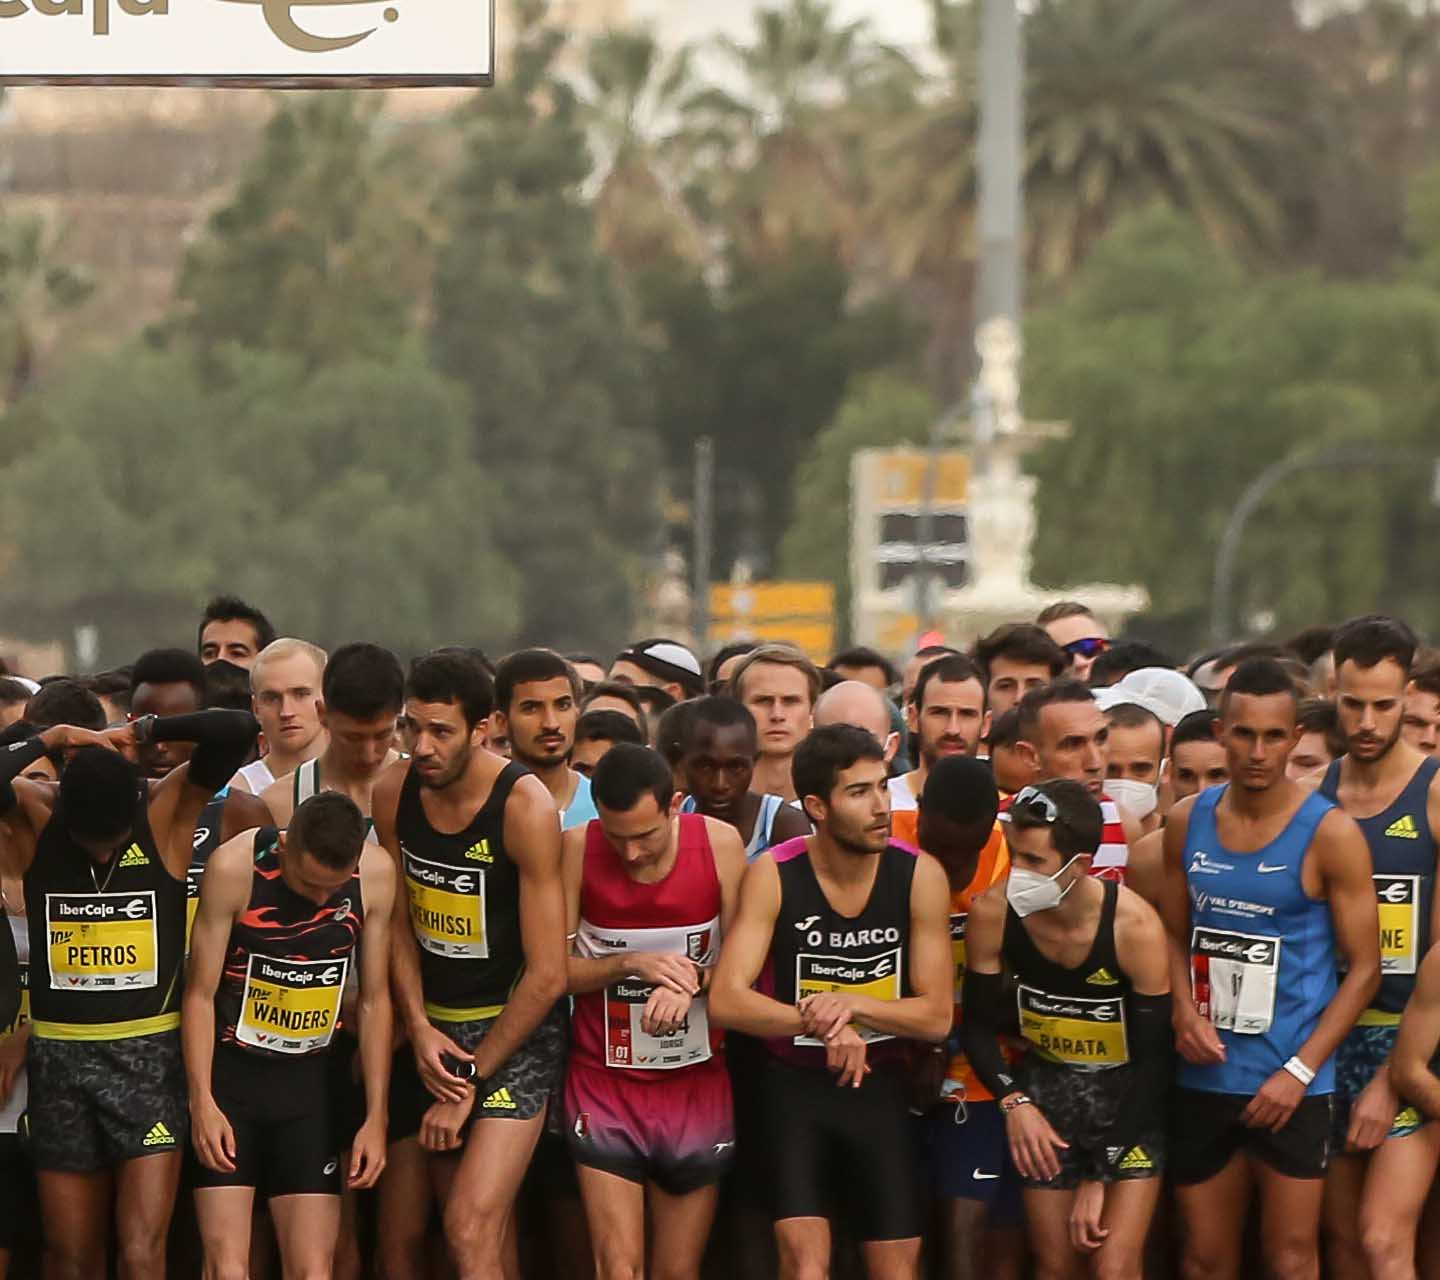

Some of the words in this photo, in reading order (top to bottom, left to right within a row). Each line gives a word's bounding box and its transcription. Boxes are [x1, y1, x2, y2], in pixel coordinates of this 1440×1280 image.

[59, 903, 115, 918] iberCaja
[807, 930, 822, 948] O
[829, 927, 900, 949] BARCO
[68, 945, 137, 966] PETROS
[262, 964, 314, 985] iberCaja
[811, 963, 866, 982] iberCaja
[617, 985, 654, 998] iberC
[253, 1001, 331, 1031] WANDERS
[1038, 1033, 1109, 1057] BARATA
[143, 1135, 176, 1147] adidas
